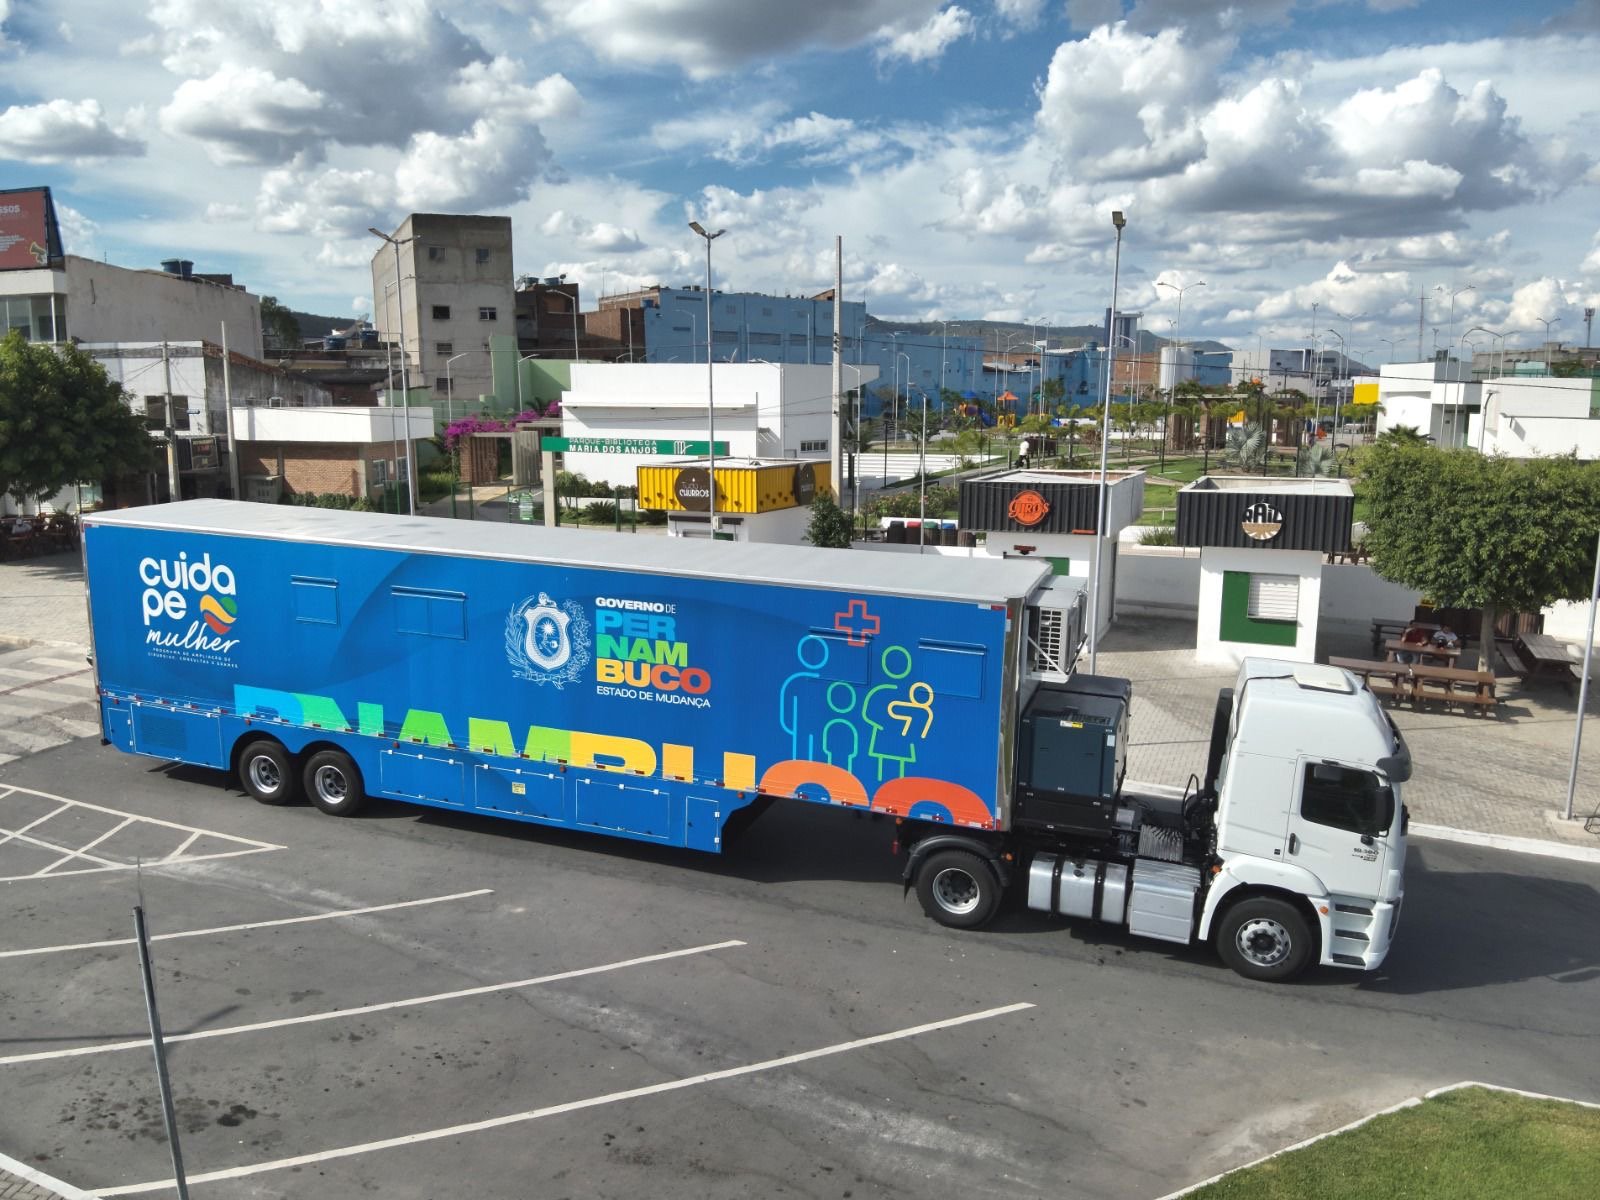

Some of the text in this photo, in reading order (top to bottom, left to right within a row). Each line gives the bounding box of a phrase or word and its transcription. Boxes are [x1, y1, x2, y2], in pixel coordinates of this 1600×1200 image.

[569, 445, 657, 454] MARIA DOS ANJOS
[679, 489, 709, 497] CHURROS
[139, 551, 236, 595] cuida
[142, 588, 187, 625] pe
[595, 597, 676, 614] GOVERNO DE
[146, 620, 240, 653] mulher
[596, 609, 676, 641] PER
[596, 633, 688, 668] NAM
[596, 657, 711, 695] BUCO
[597, 685, 711, 709] ESTADO DE MUDANÇA
